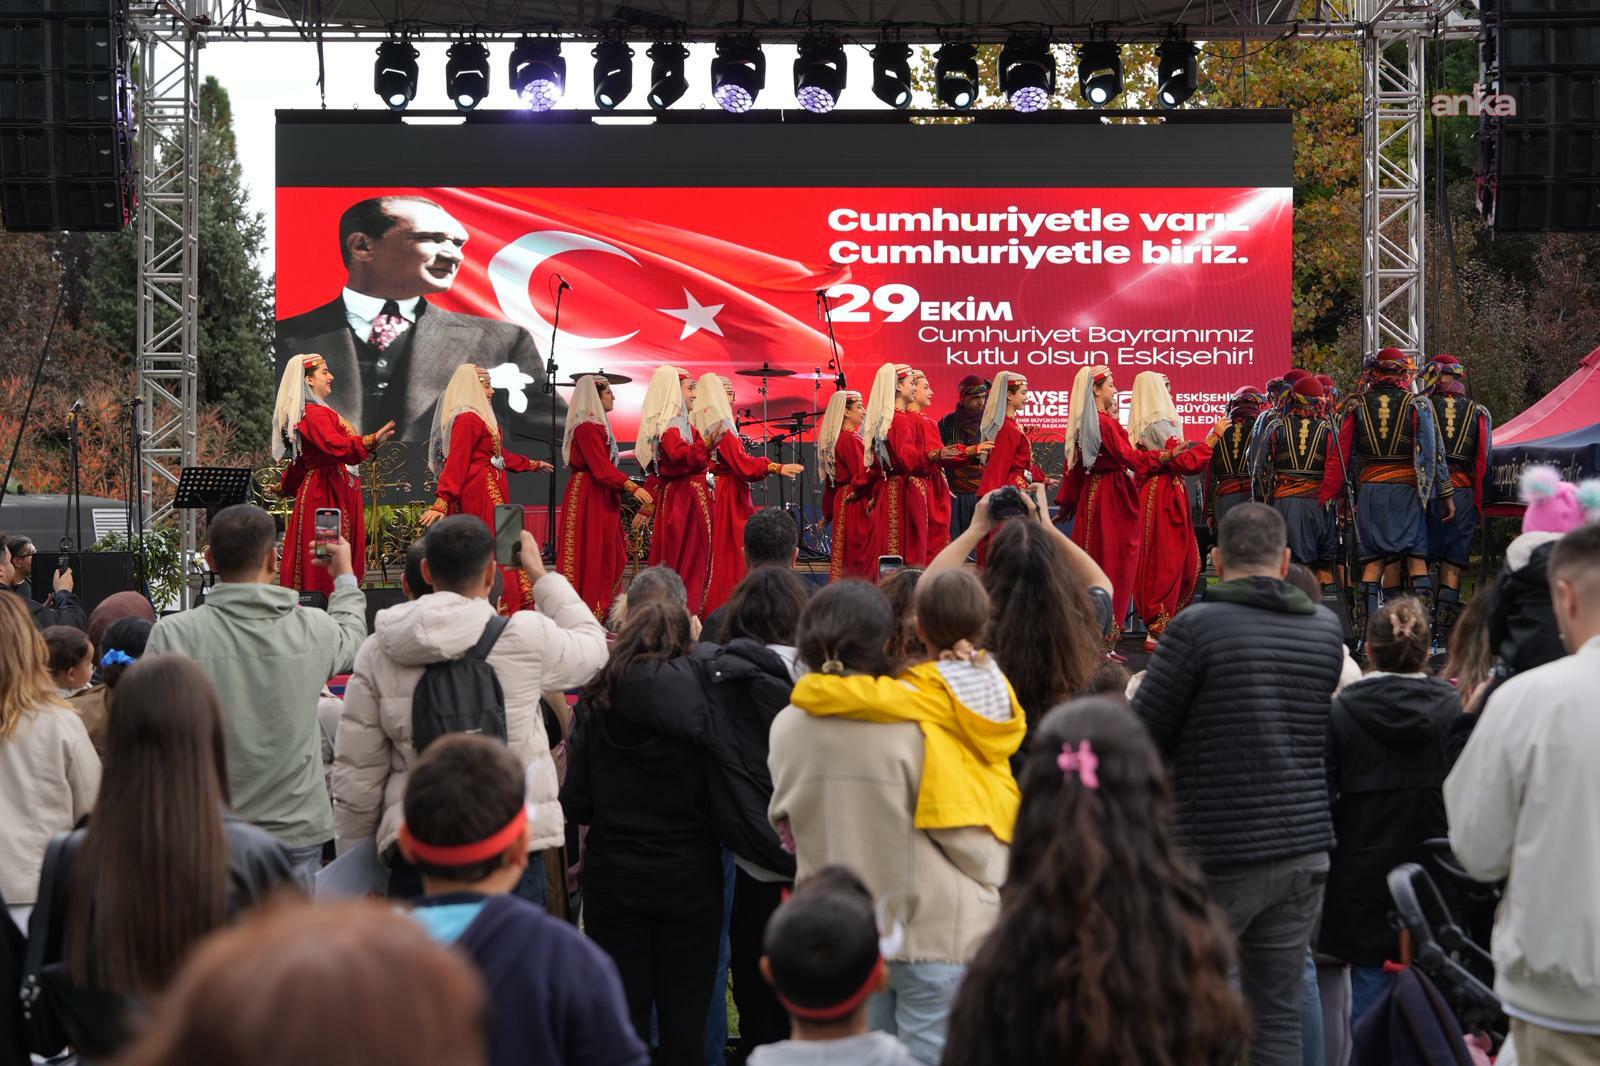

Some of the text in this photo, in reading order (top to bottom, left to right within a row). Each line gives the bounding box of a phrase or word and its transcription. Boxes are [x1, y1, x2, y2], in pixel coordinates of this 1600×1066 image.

[828, 206, 1250, 237] Cumhuriyetle varız
[829, 238, 1249, 269] Cumhuriyetle biriz.
[824, 283, 1014, 322] 29 EKİM
[917, 325, 1254, 346] Cumhuriyet Bayramımız
[946, 346, 1254, 368] kutlu olsun Eskişehir!
[1015, 402, 1069, 416] NLÜCE
[1176, 403, 1227, 414] BÜYÜKŞ
[1179, 414, 1222, 424] BELEDİ
